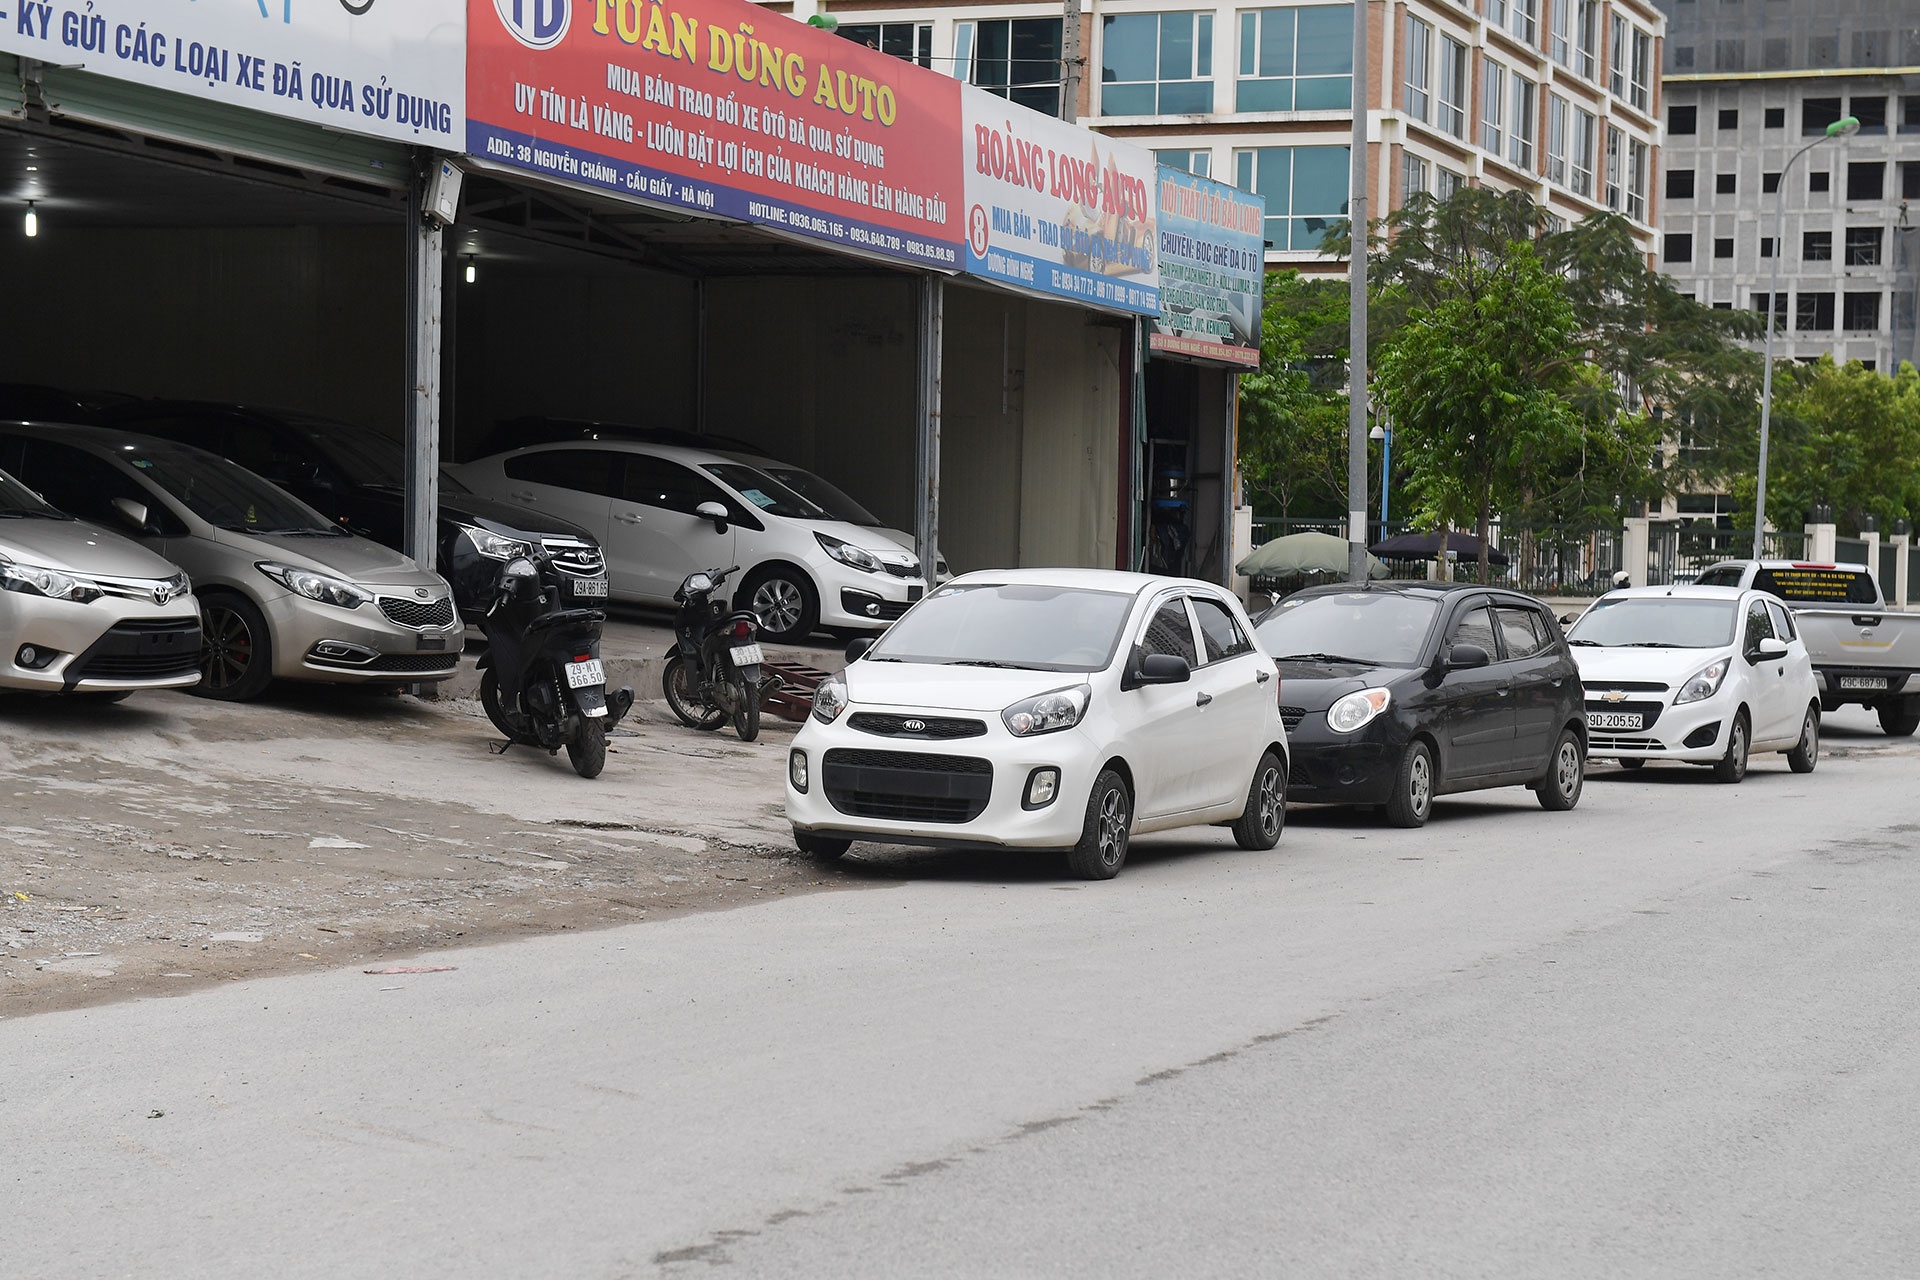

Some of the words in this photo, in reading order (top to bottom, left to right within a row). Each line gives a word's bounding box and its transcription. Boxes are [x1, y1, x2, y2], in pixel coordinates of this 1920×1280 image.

[62, 0, 106, 54] GỬI
[115, 22, 167, 68] CÁC
[174, 38, 228, 87] LOẠI
[236, 53, 266, 92] XE
[272, 60, 304, 101] ĐÃ
[311, 72, 355, 113] QUA
[361, 75, 393, 120] SỬ
[396, 92, 451, 134] DỤNG
[707, 22, 807, 98] DŨNG
[813, 63, 897, 126] AUTO
[607, 63, 641, 98] MUA
[644, 73, 674, 108] BÁN
[678, 85, 712, 119] TRAO
[715, 91, 739, 126] ĐỔI
[742, 104, 759, 132] XE
[762, 106, 786, 139] ÔTÔ
[789, 117, 806, 147] ĐÃ
[808, 125, 833, 154] QUA
[835, 126, 853, 159] SỬ
[854, 138, 885, 169] DỤNG
[486, 136, 514, 159] ADD:
[516, 145, 531, 163] 38
[533, 148, 578, 175] NGUYỄN
[580, 161, 617, 185] CHÁNH
[626, 170, 647, 192] CẦU
[650, 177, 673, 198] GIẤY
[681, 186, 695, 204] HÀ
[697, 188, 714, 209] NỘI
[514, 82, 536, 116] UY
[540, 86, 566, 125] TÍN
[570, 95, 589, 132] LÀ
[593, 102, 633, 143] VÀNG
[647, 120, 685, 158] LUÔN
[688, 130, 714, 168] ĐẶT
[717, 140, 738, 175] LỢI
[741, 140, 763, 177] ÍCH
[766, 145, 792, 185] CỦA
[795, 162, 835, 197] KHÁCH
[838, 172, 869, 206] HÀNG
[871, 180, 892, 212] LÊN
[894, 188, 924, 220] HÀNG
[926, 192, 947, 225] ĐẦU
[975, 120, 1045, 193] HOÀNG
[1048, 149, 1098, 209] LONG
[1102, 168, 1147, 224] AUTO
[749, 201, 788, 224] HOTLINE:
[789, 211, 844, 238] 0936.065.165
[850, 227, 900, 251] 0934.648.789
[906, 240, 955, 263] 0983.85.88.99
[973, 206, 986, 249] 8
[992, 206, 1012, 234] MUA
[1013, 209, 1031, 240] BÁN
[1038, 219, 1058, 248] TRAO
[1161, 176, 1178, 221] NỘI
[1179, 179, 1201, 222] THẤT
[1201, 186, 1208, 224] Ô
[1209, 190, 1220, 227] TÔ
[1221, 190, 1238, 231] BẢO
[1239, 203, 1261, 236] LONG
[1160, 231, 1194, 259] CHUYÊN:
[1196, 240, 1212, 266] BỌC
[1213, 241, 1229, 267] GHẾ
[1230, 249, 1240, 270] DA
[1241, 247, 1247, 271] Ô
[1248, 249, 1258, 273] TÔ
[570, 672, 603, 687] 366.50
[905, 721, 921, 730] KIA
